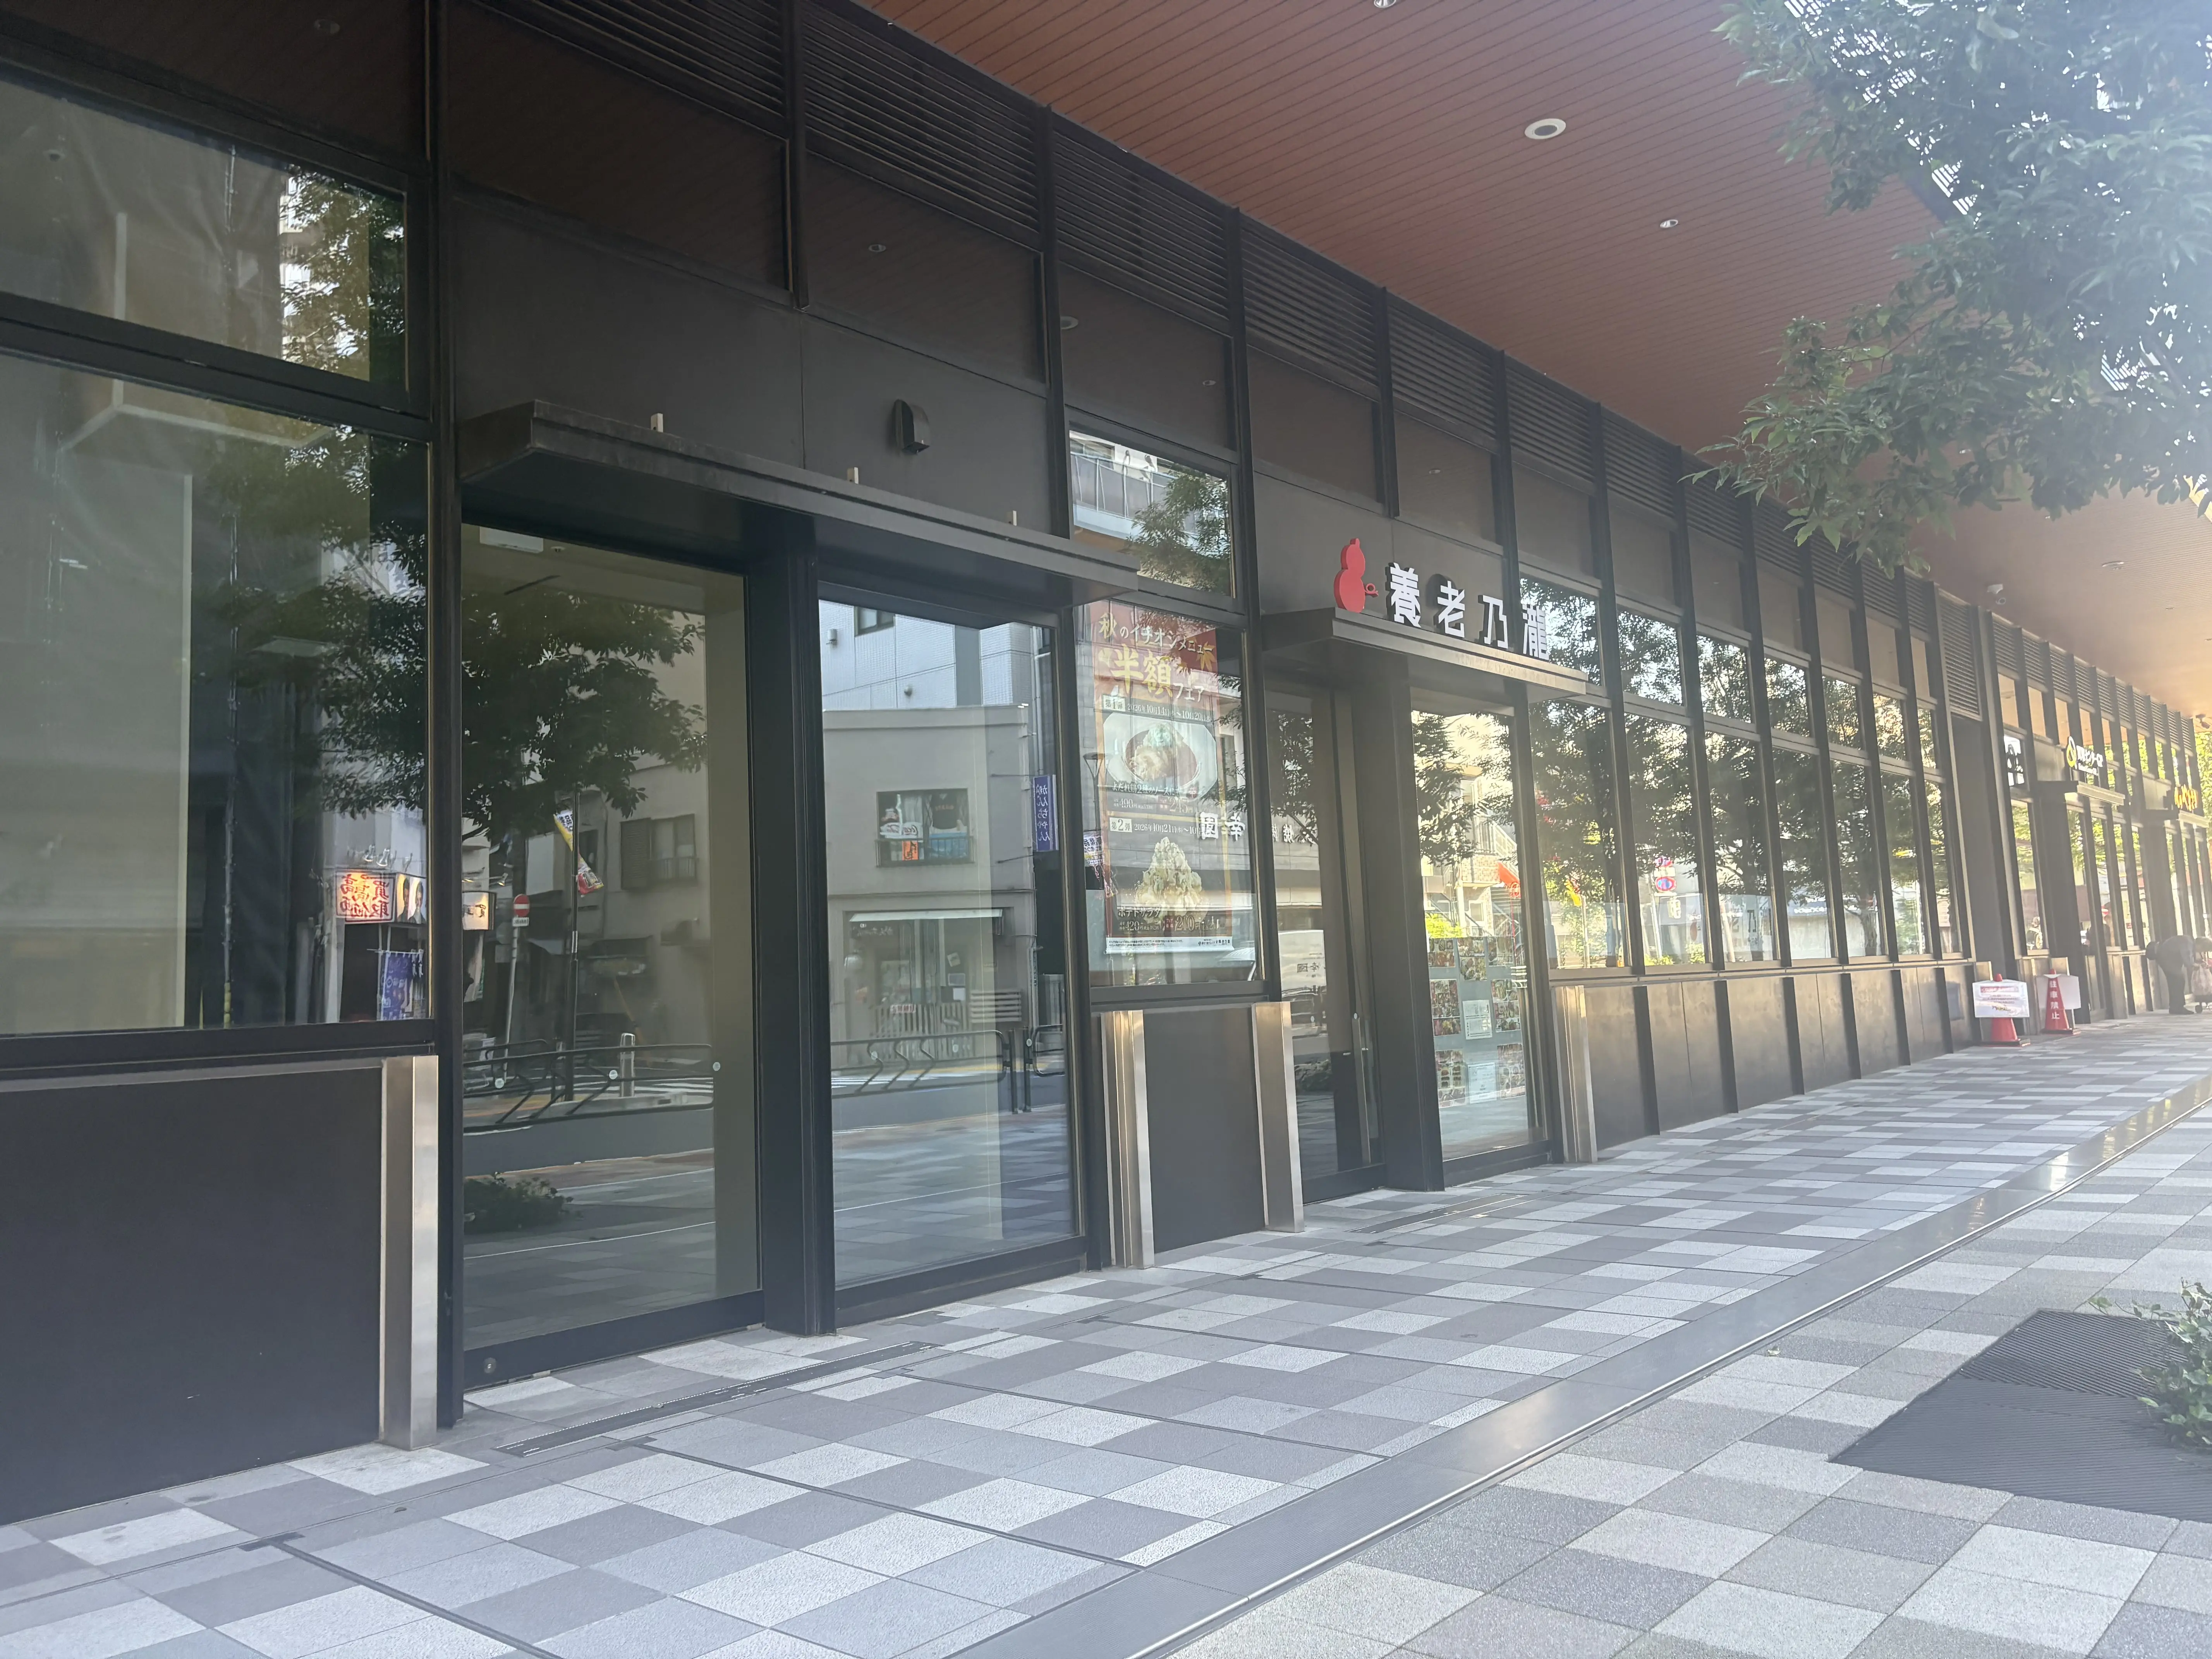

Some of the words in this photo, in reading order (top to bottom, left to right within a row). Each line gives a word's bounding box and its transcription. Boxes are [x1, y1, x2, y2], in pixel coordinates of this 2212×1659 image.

[1099, 611, 1214, 654] 秋のイチオシメニュー
[1389, 563, 1549, 660] 養老乃瀧
